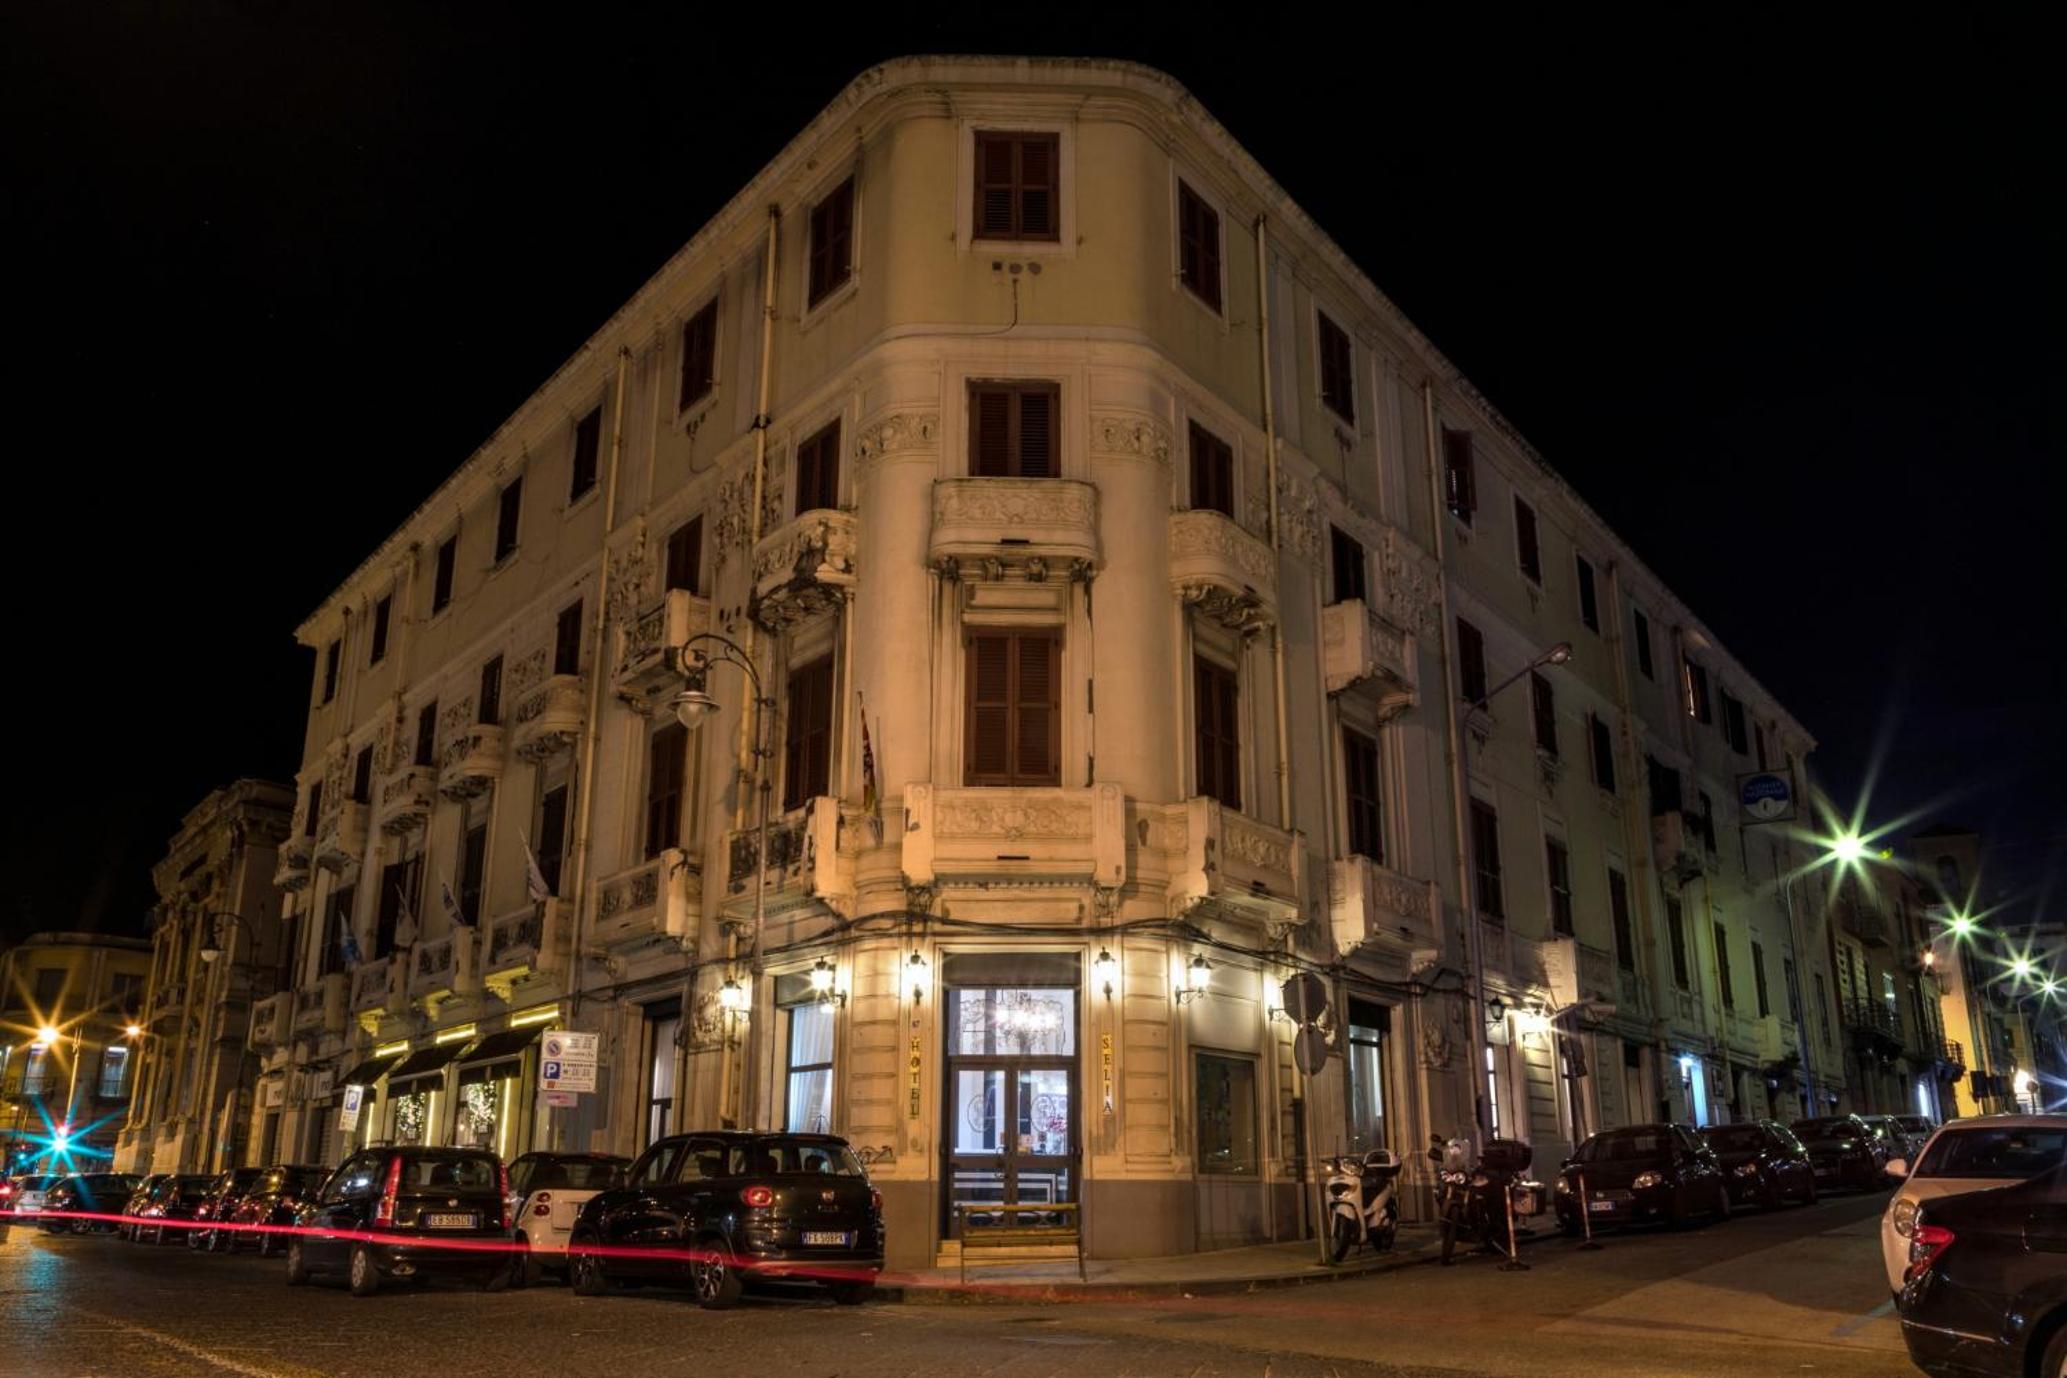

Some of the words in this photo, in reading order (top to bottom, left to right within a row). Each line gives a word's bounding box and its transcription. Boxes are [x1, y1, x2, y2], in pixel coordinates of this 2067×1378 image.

[547, 1064, 557, 1077] P
[911, 1041, 921, 1115] HOTEL
[1102, 1037, 1112, 1113] SELIA
